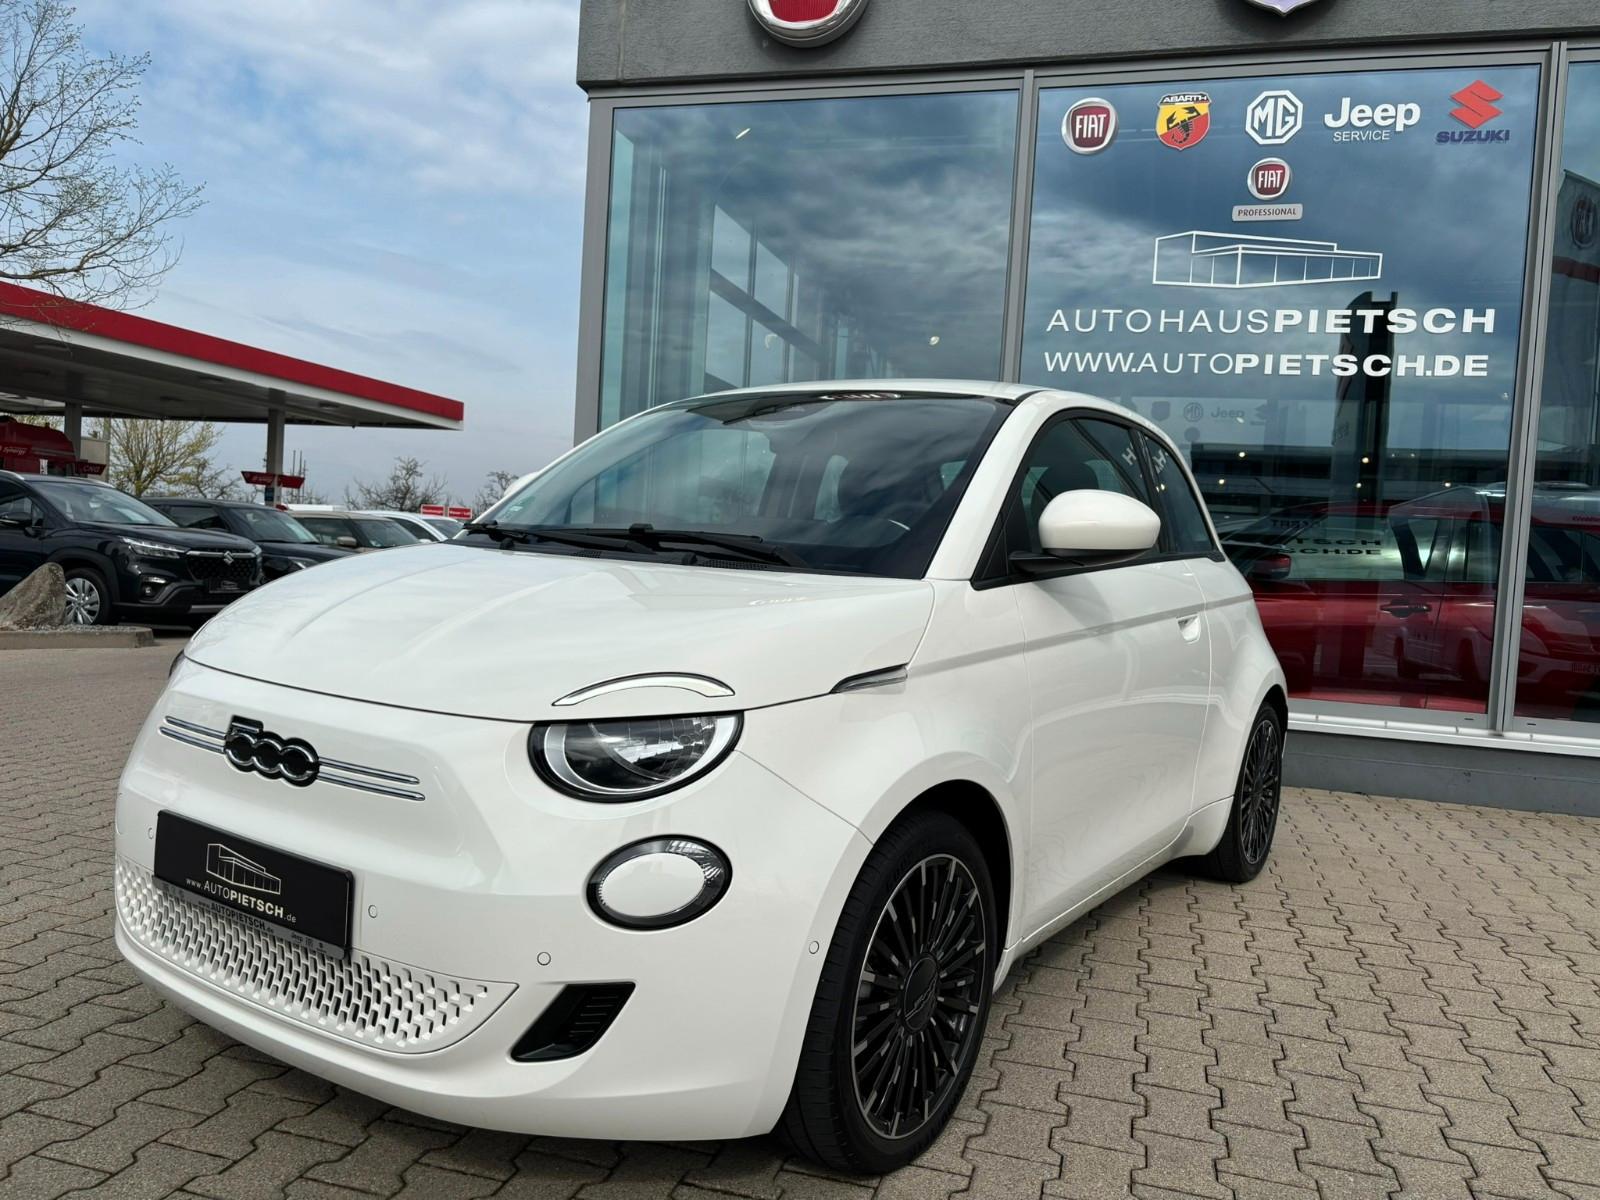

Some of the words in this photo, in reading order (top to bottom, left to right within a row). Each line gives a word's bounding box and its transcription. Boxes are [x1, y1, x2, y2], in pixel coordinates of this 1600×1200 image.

[1162, 93, 1208, 104] ABARTH
[1075, 113, 1107, 138] FIAT
[1253, 98, 1296, 137] MG
[1324, 97, 1421, 132] Jeep
[1333, 130, 1391, 143] SERVICE
[1436, 129, 1510, 144] SUZUKI
[1257, 169, 1284, 189] FIAT
[1237, 207, 1298, 217] PROFESSIONAL
[1046, 307, 1496, 334] AUTOHAUSPIETSCH
[1044, 351, 1489, 377] WWW.AUTOPIETSCH.DE
[224, 715, 320, 788] 500
